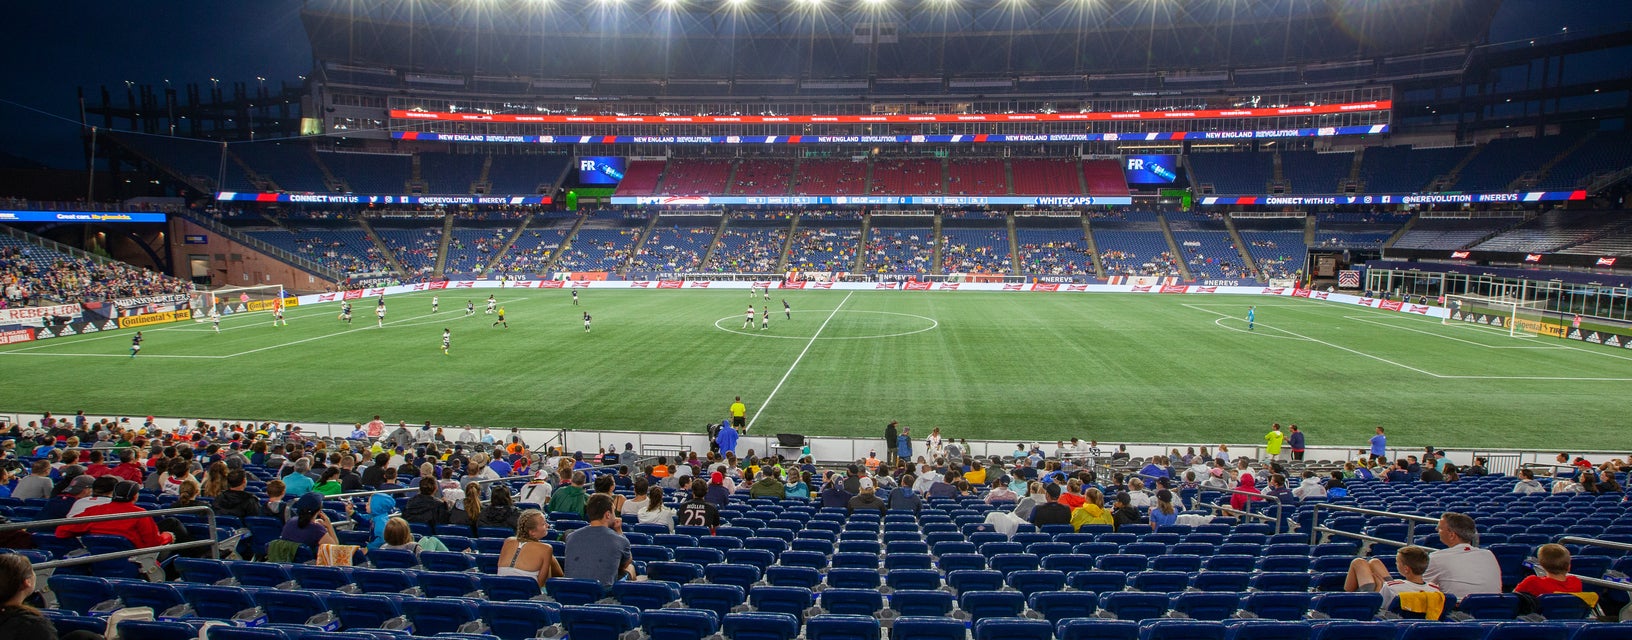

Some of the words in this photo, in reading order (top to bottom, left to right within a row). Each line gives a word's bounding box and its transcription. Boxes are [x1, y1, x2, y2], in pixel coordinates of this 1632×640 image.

[581, 160, 596, 171] FR
[1128, 159, 1144, 170] FR
[289, 194, 327, 202] CONNECT
[1402, 195, 1471, 204] @NEREVOLUTION
[9, 305, 81, 319] REBELLION
[122, 313, 165, 327] Continental
[525, 485, 537, 499] 7
[684, 510, 706, 527] 25
